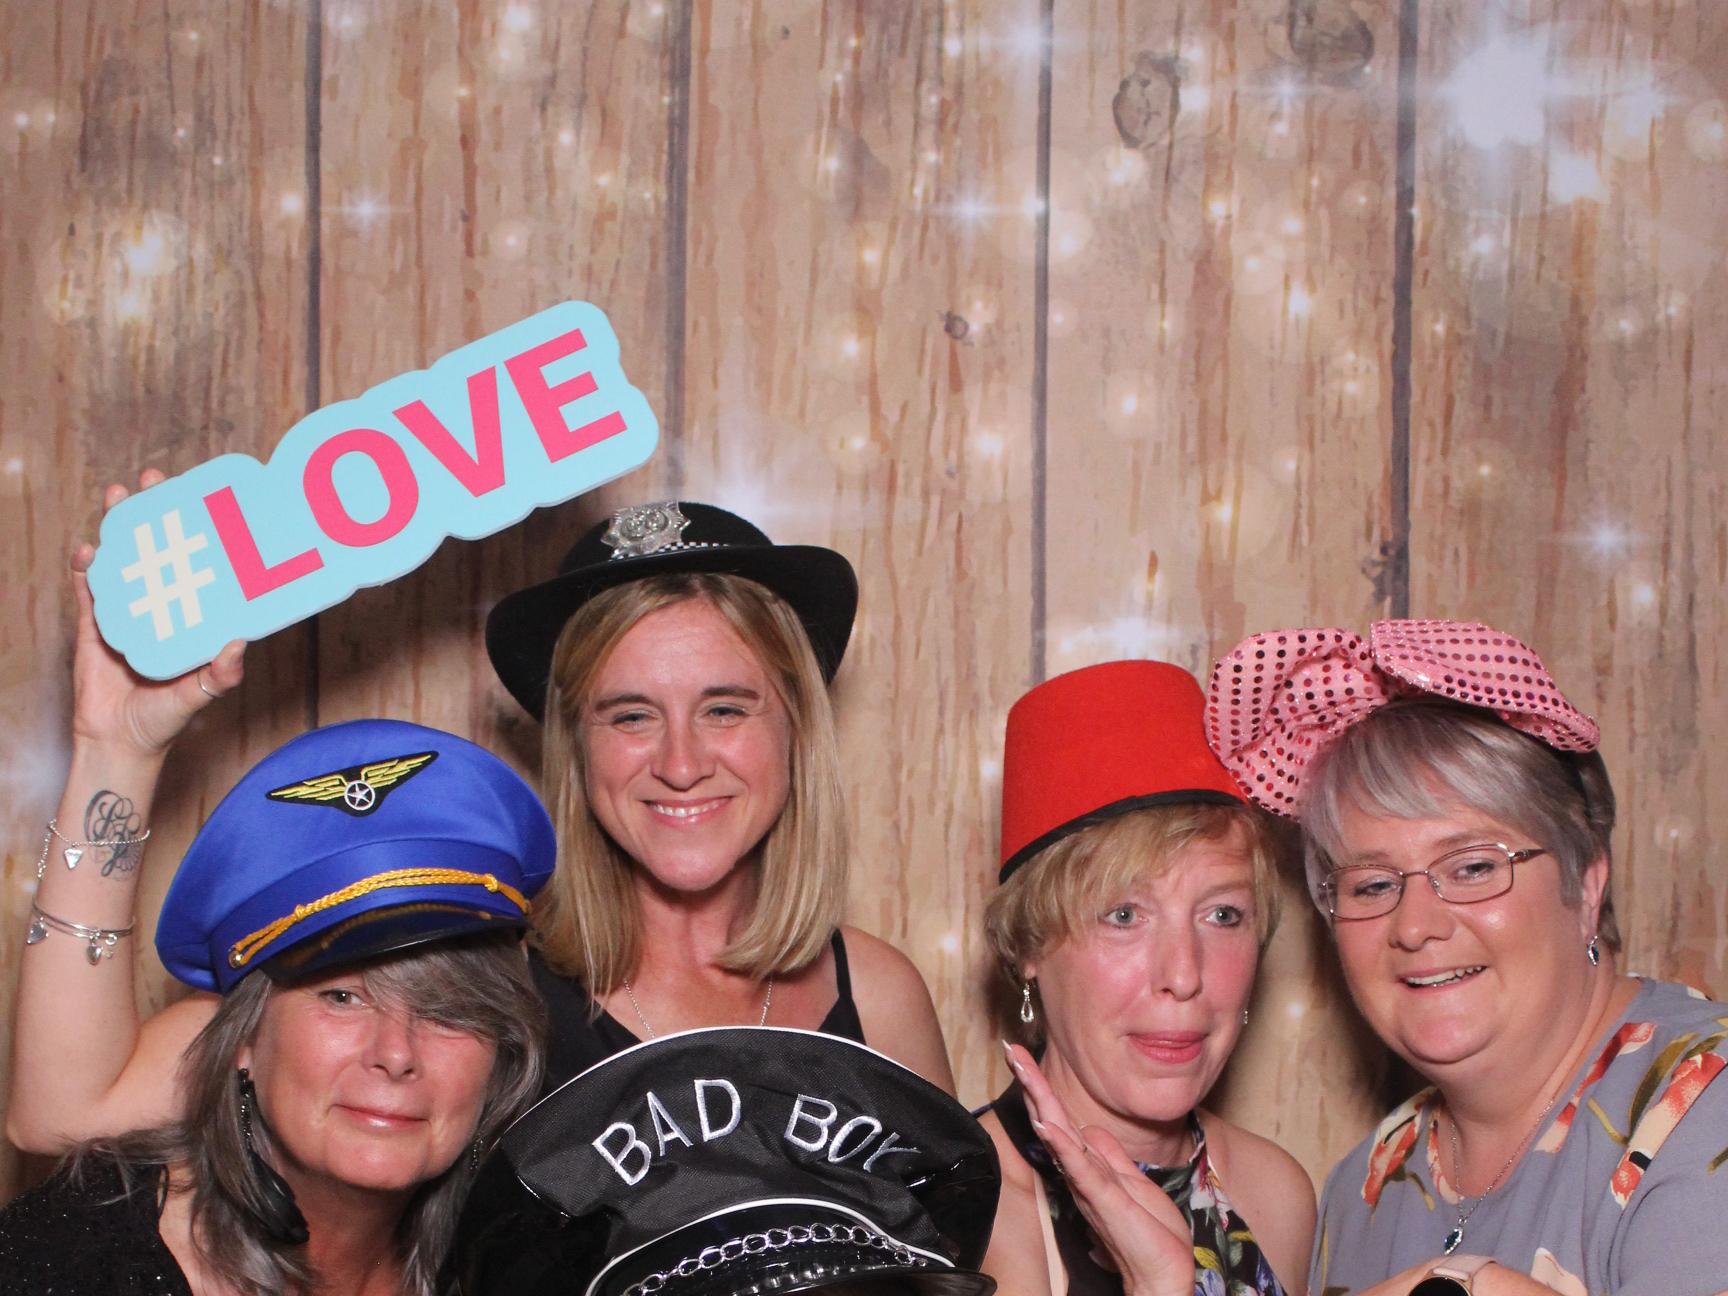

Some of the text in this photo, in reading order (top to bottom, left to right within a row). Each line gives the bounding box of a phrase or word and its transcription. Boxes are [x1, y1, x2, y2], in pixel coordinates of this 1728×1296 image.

[121, 328, 628, 641] #LOVE
[592, 1078, 922, 1186] BAD BOY
